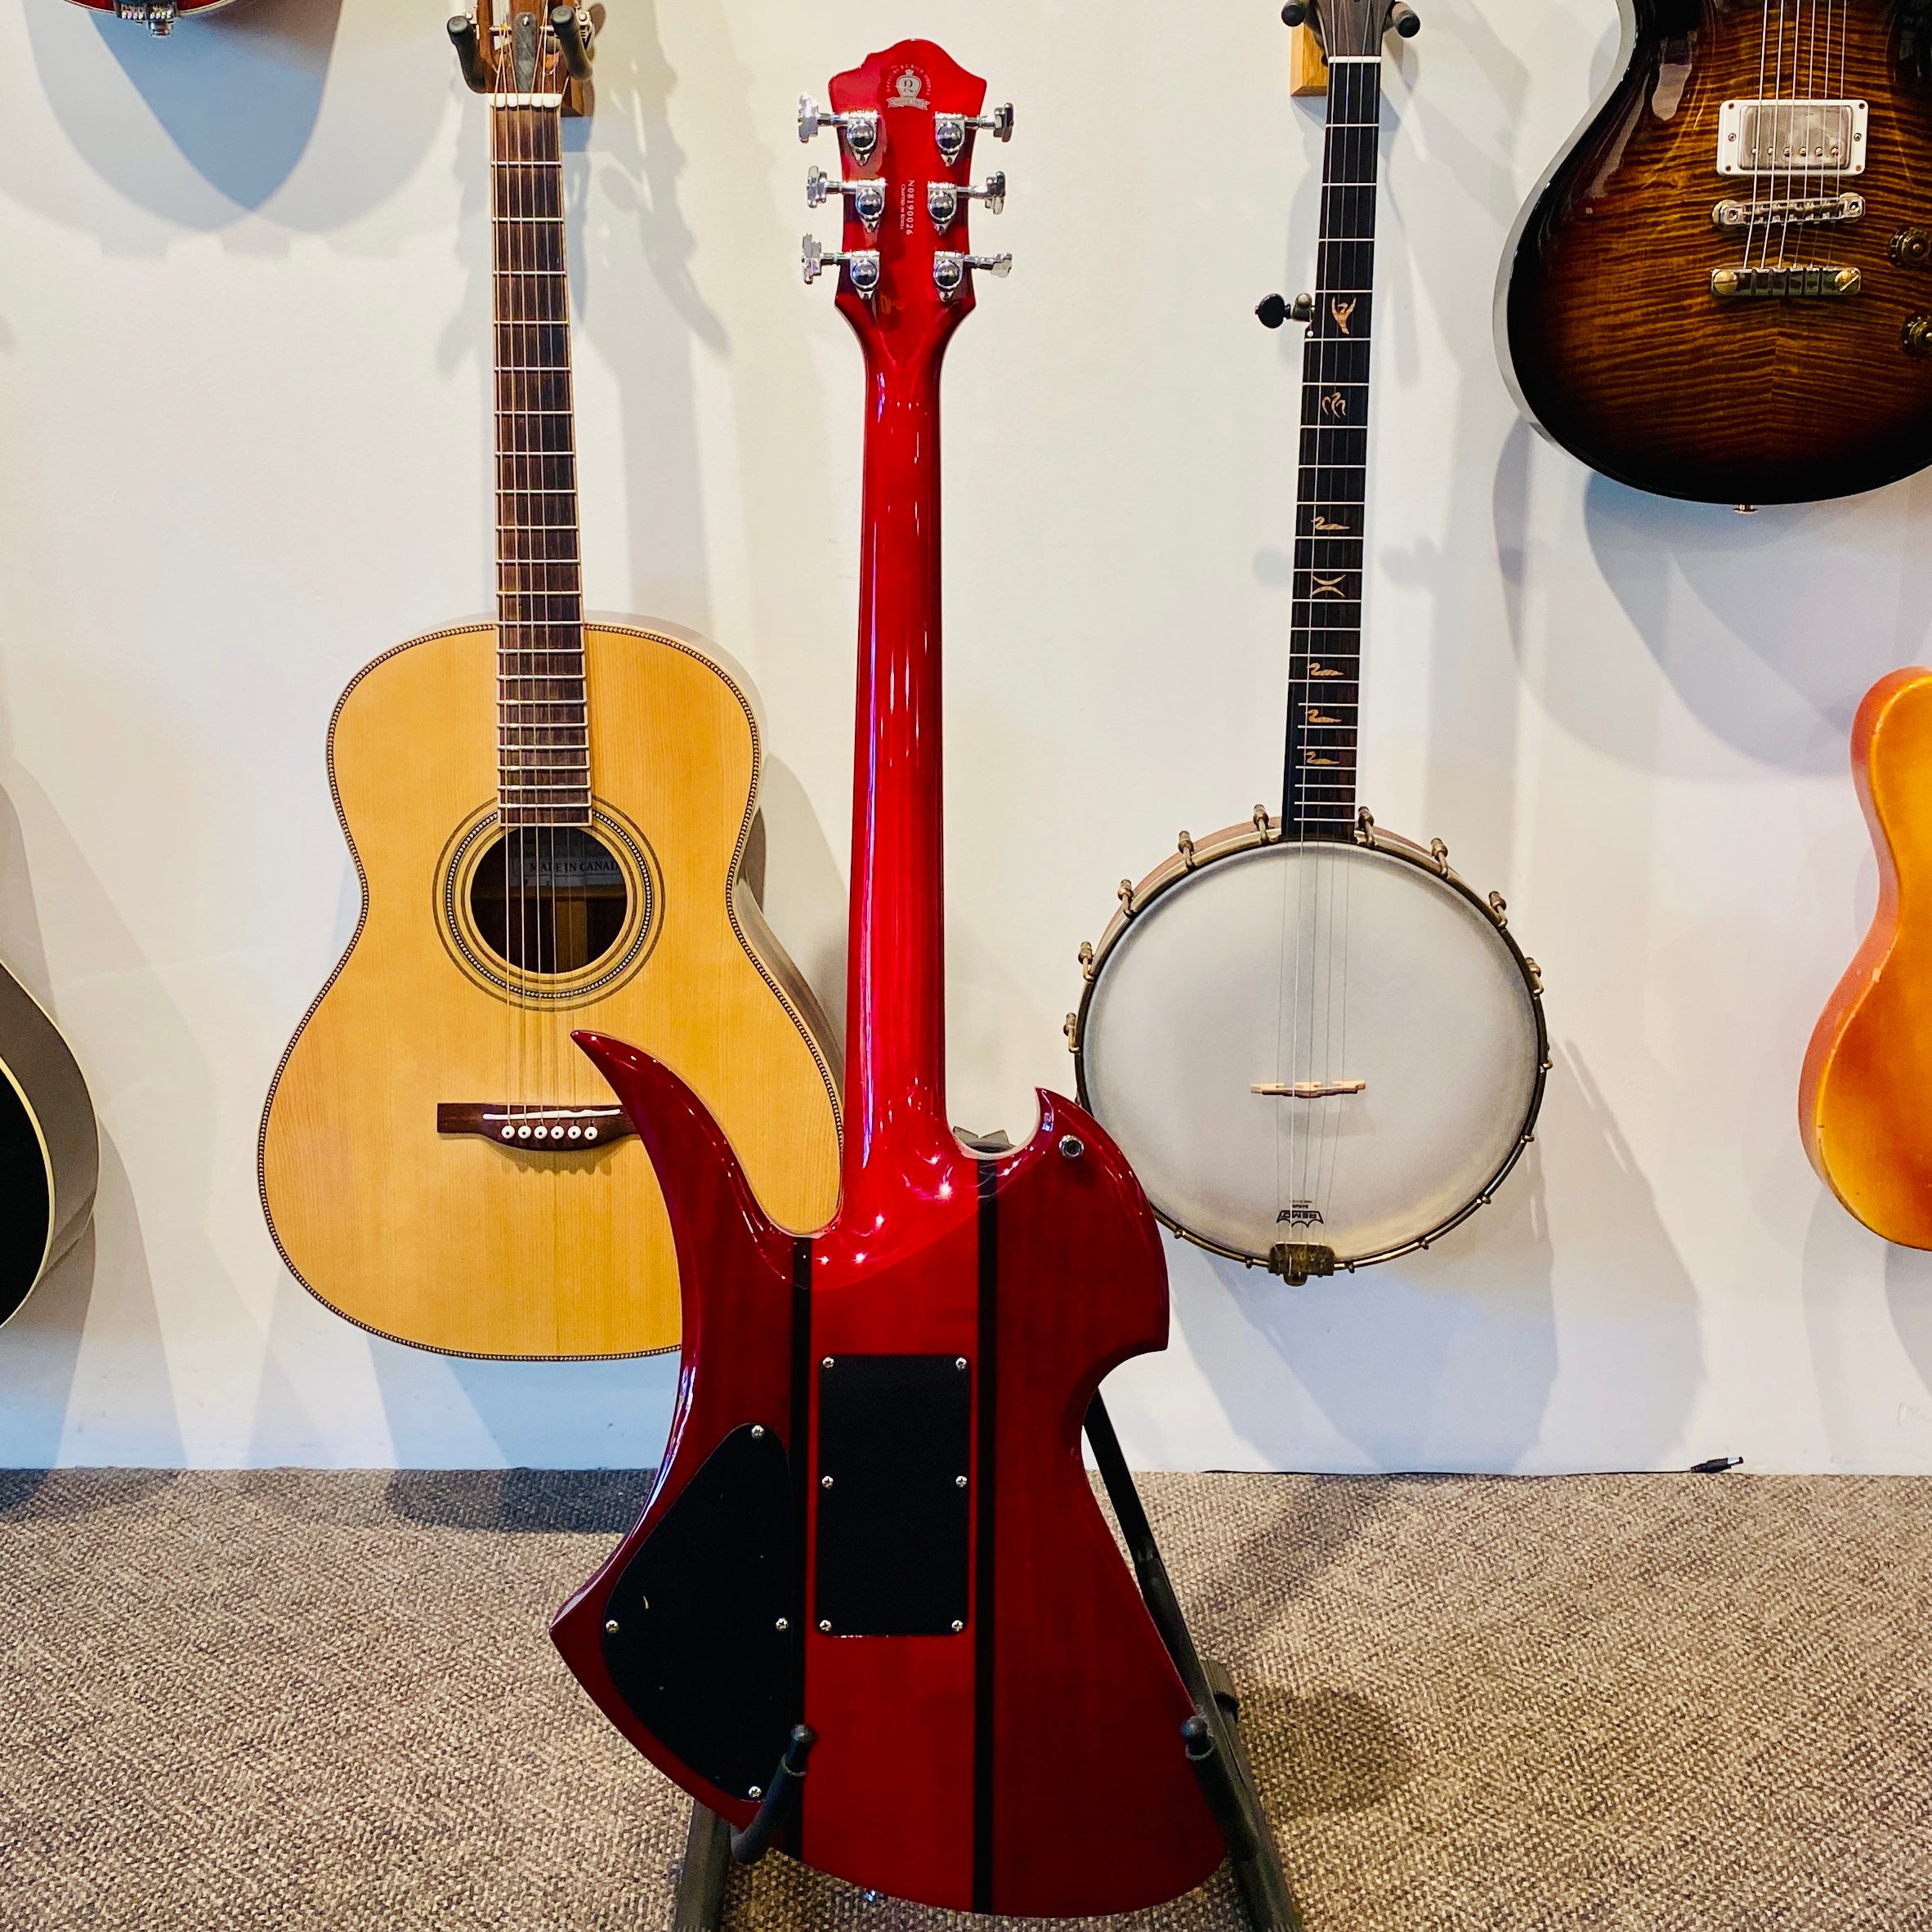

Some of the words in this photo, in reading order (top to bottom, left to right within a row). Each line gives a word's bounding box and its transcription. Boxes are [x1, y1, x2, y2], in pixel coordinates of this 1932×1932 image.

[906, 179, 915, 235] N08190026
[530, 861, 562, 872] MADE
[565, 861, 577, 872] IN
